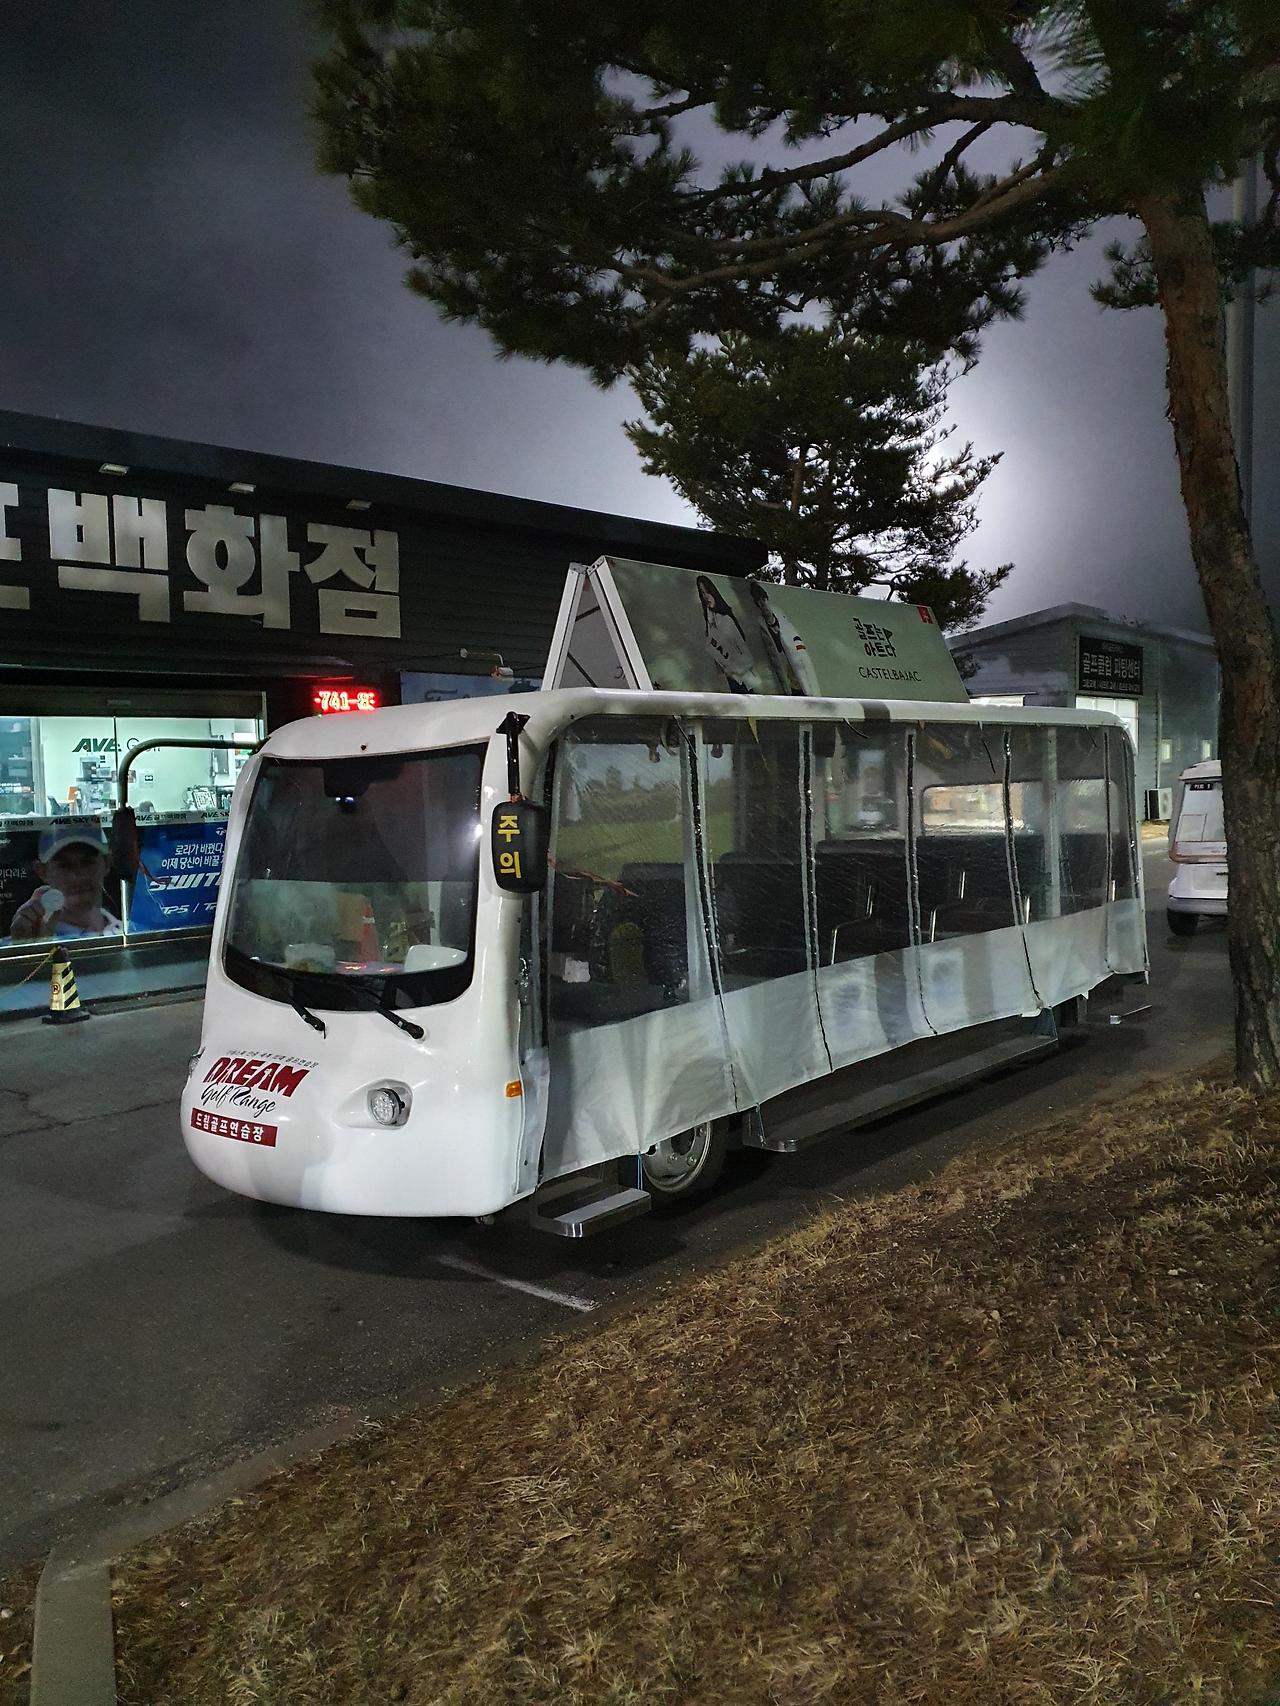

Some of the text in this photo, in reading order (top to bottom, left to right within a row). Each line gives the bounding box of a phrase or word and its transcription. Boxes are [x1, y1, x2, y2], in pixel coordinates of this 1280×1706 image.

[0, 482, 401, 638] 백화점
[859, 667, 922, 682] CASTELBAJAC
[1083, 652, 1112, 677] 골프클럽
[175, 843, 199, 856] 로리가
[498, 815, 522, 879] 주의
[161, 857, 179, 870] 이제
[179, 856, 203, 870] 당신이
[203, 1057, 310, 1097] DREAM
[201, 1082, 276, 1118] Golf Range
[196, 1113, 264, 1142] 드림골프연습장
